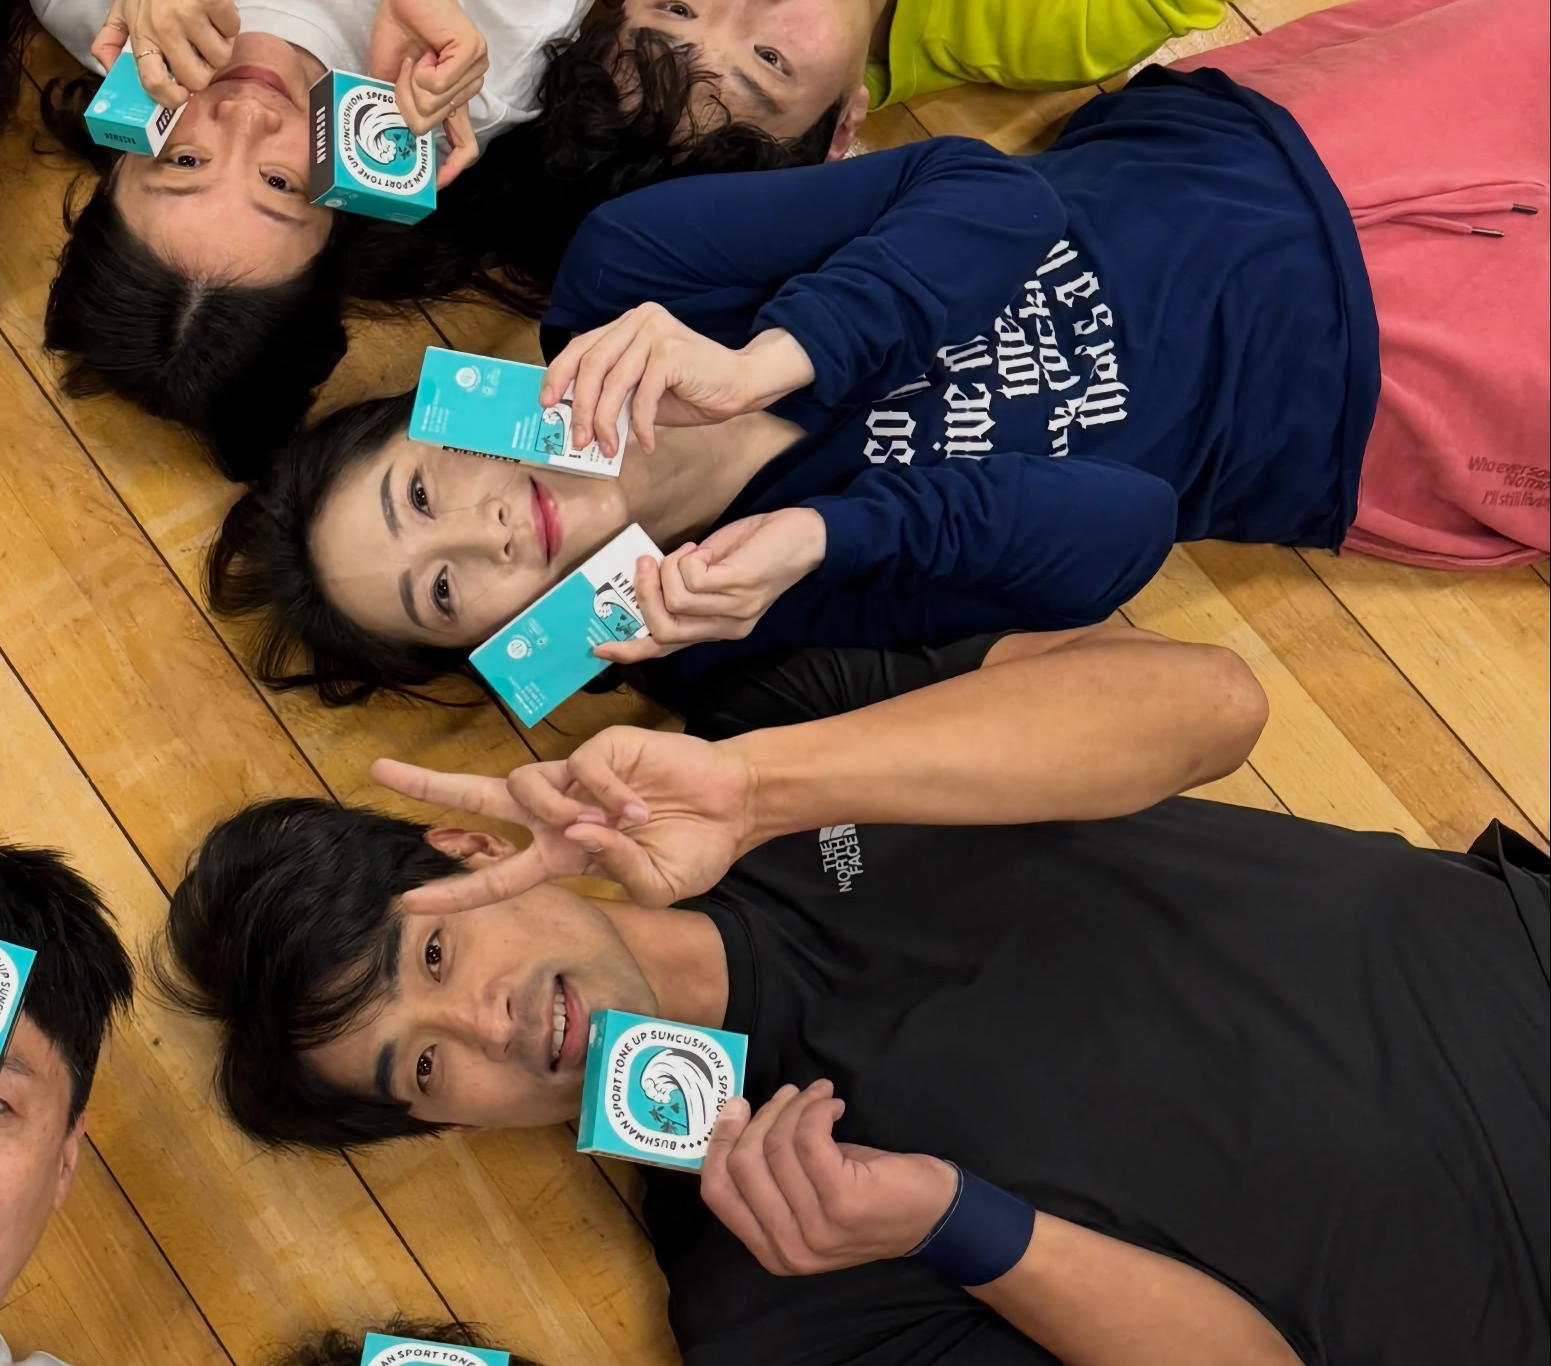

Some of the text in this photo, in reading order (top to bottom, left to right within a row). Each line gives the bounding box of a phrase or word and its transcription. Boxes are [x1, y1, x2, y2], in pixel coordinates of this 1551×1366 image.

[820, 840, 836, 873] THE
[831, 838, 853, 892] NORTH
[844, 835, 864, 875] FACE
[632, 1032, 647, 1046] UP
[651, 1030, 724, 1069] SUNCUSHION
[614, 1042, 633, 1075] TONE
[611, 1077, 625, 1118] SPORT
[620, 1120, 677, 1151] BUSHMAN
[397, 1349, 439, 1360] SPORT
